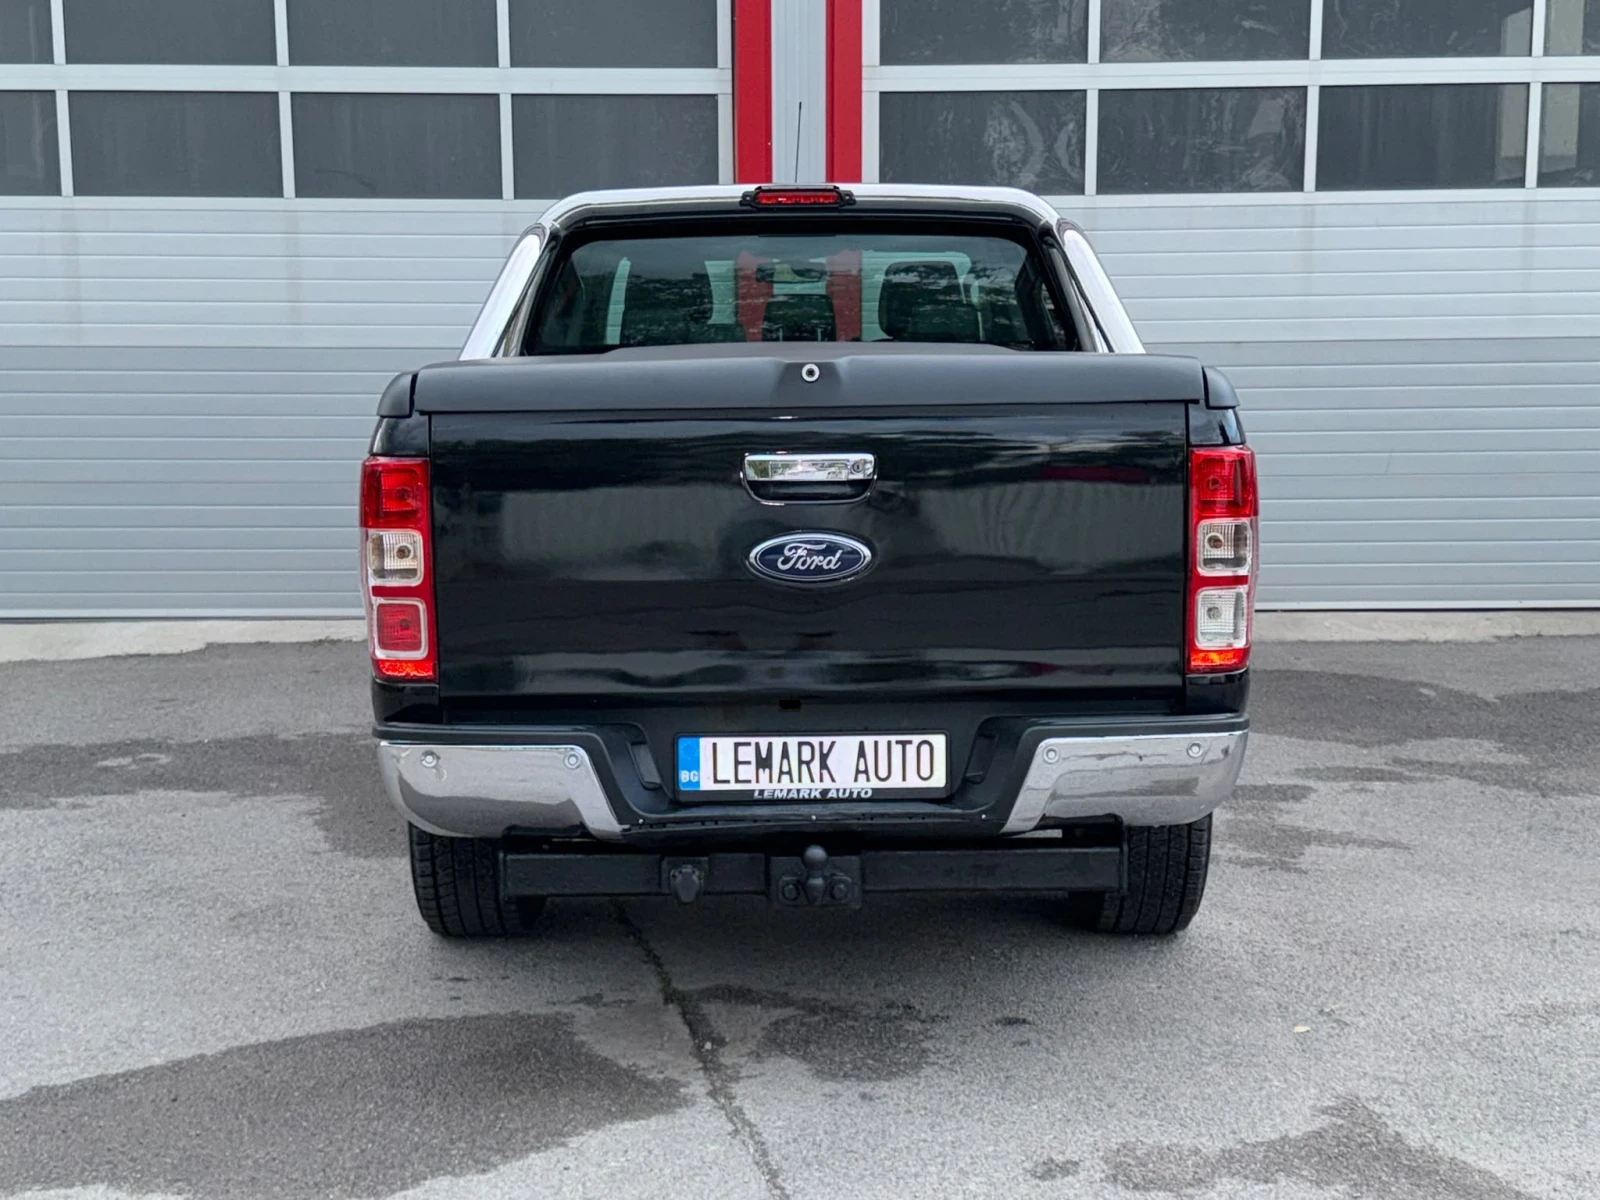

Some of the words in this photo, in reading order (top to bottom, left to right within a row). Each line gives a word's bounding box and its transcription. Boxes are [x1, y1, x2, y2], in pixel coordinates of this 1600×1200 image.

[777, 542, 843, 571] Ford
[712, 740, 836, 784] LEMARK
[853, 739, 934, 783] AUTO
[680, 770, 699, 782] BG
[753, 788, 822, 800] LEMARK
[825, 787, 873, 799] AUTO
